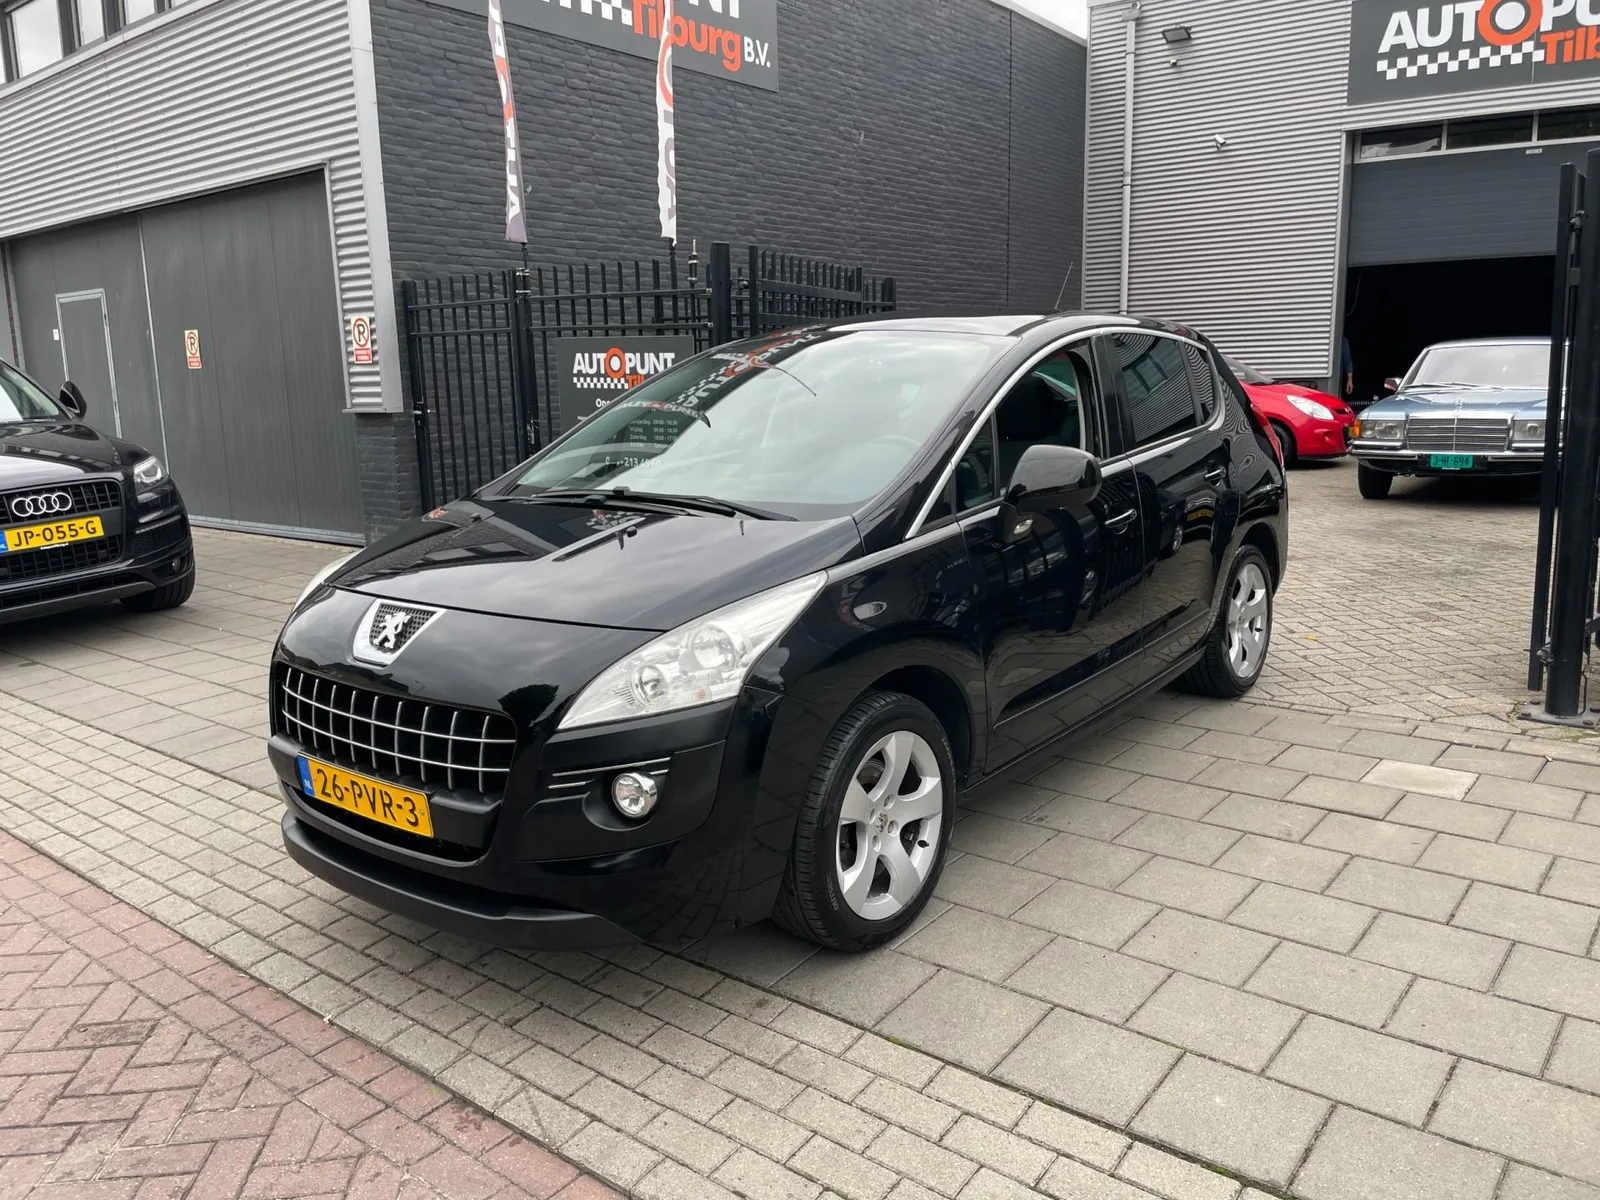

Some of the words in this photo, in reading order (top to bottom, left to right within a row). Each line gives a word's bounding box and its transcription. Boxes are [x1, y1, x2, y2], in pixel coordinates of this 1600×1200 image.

[743, 36, 771, 68] B.V.
[572, 347, 676, 379] AUTOPUNT
[14, 520, 97, 548] JP-055-G
[317, 768, 420, 827] 26-PVR-3
